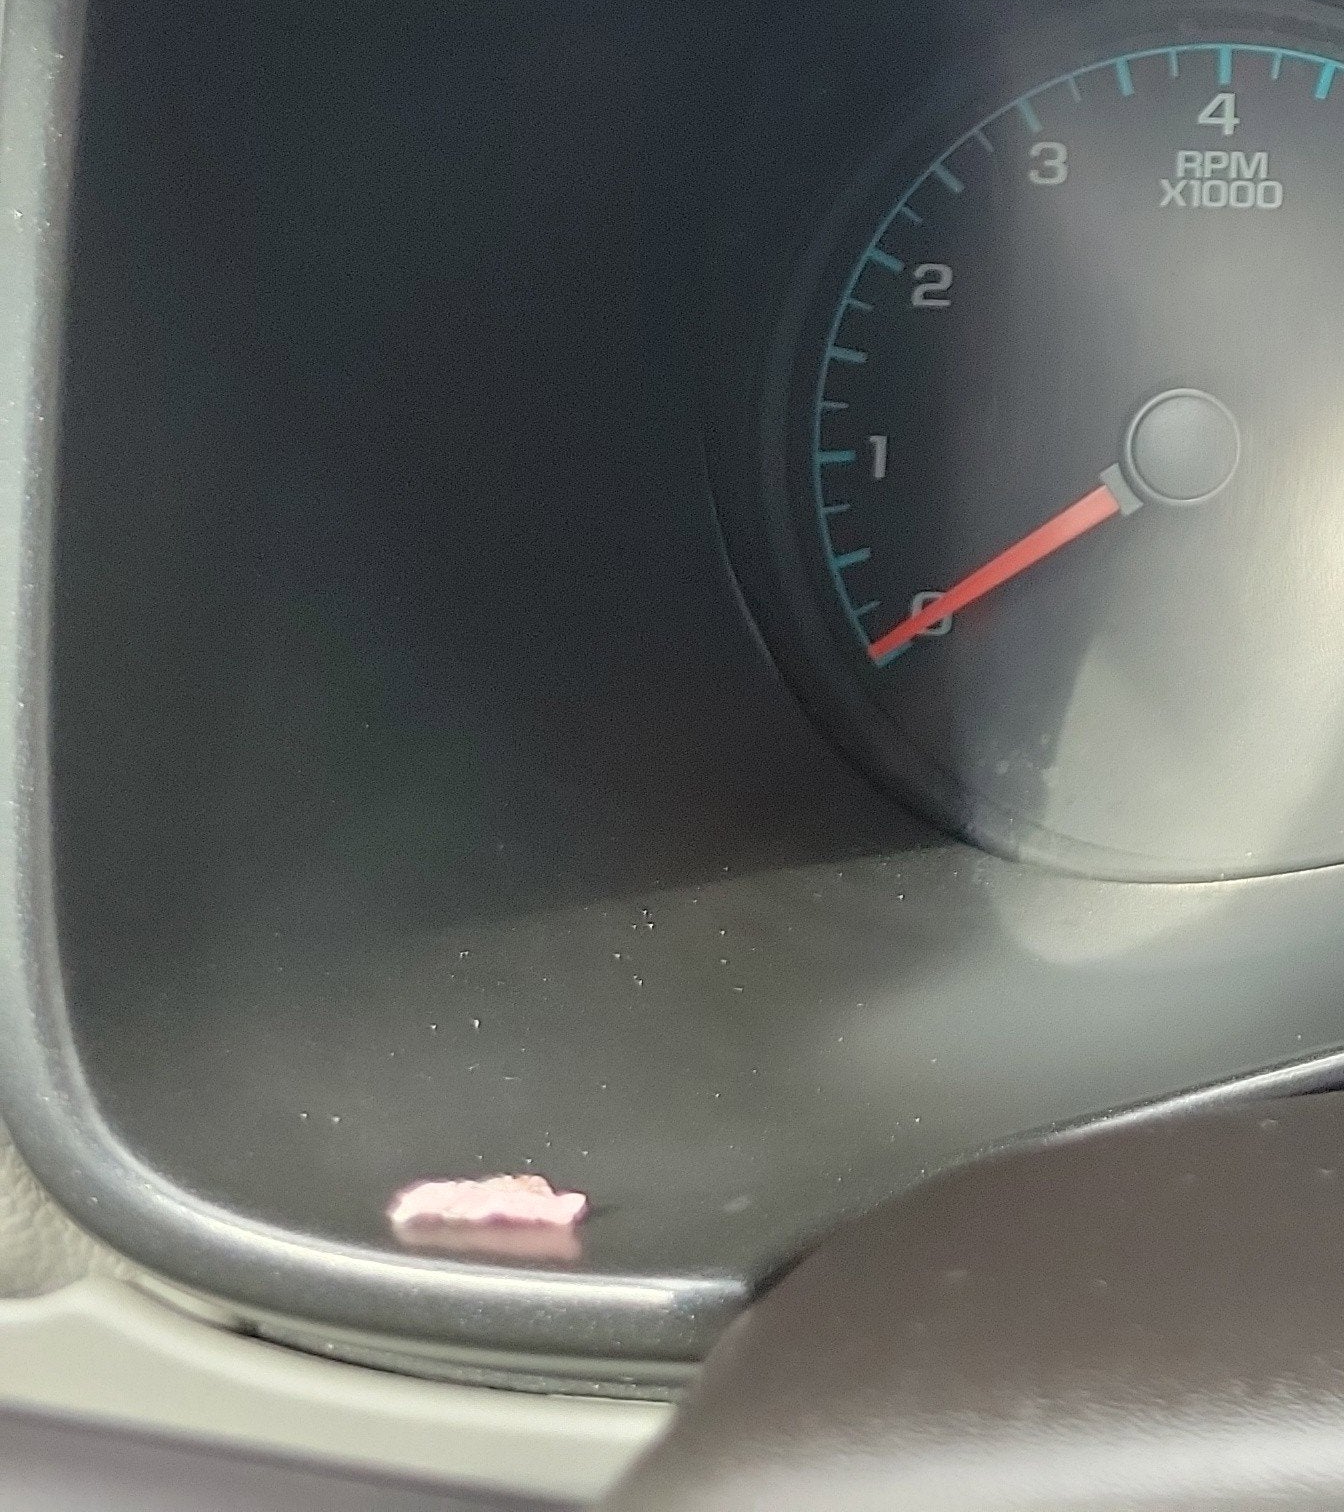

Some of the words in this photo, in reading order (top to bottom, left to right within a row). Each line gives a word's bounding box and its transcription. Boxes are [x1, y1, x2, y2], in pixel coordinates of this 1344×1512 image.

[1196, 92, 1241, 137] 4
[1027, 140, 1070, 187] 3
[1175, 149, 1269, 181] RPM
[1158, 179, 1284, 211] X1000
[910, 262, 954, 309] 2
[867, 434, 890, 480] 1
